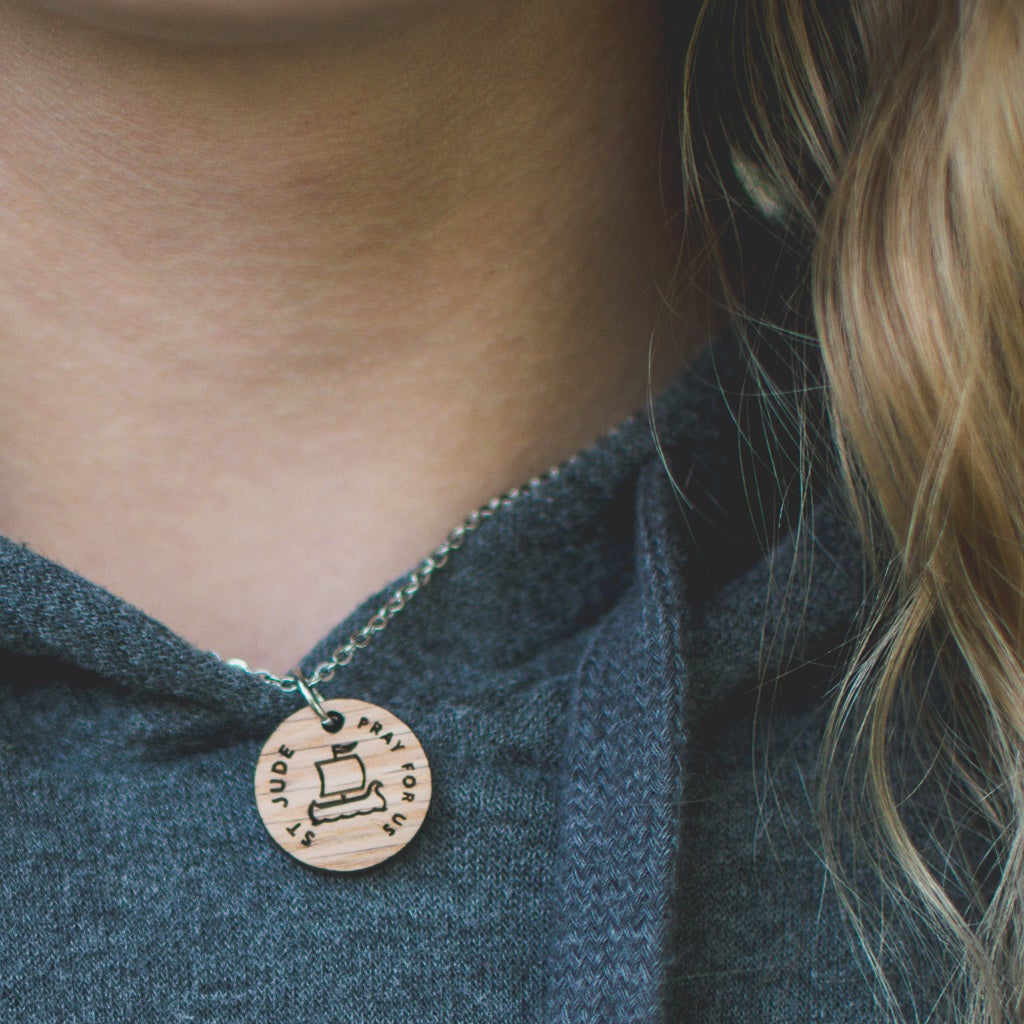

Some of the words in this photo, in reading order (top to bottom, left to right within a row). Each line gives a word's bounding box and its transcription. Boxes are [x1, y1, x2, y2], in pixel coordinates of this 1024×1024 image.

[357, 716, 405, 752] PRAY
[269, 744, 295, 808] JUDE
[401, 762, 417, 802] FOR
[286, 822, 316, 847] ST
[382, 813, 407, 836] US
